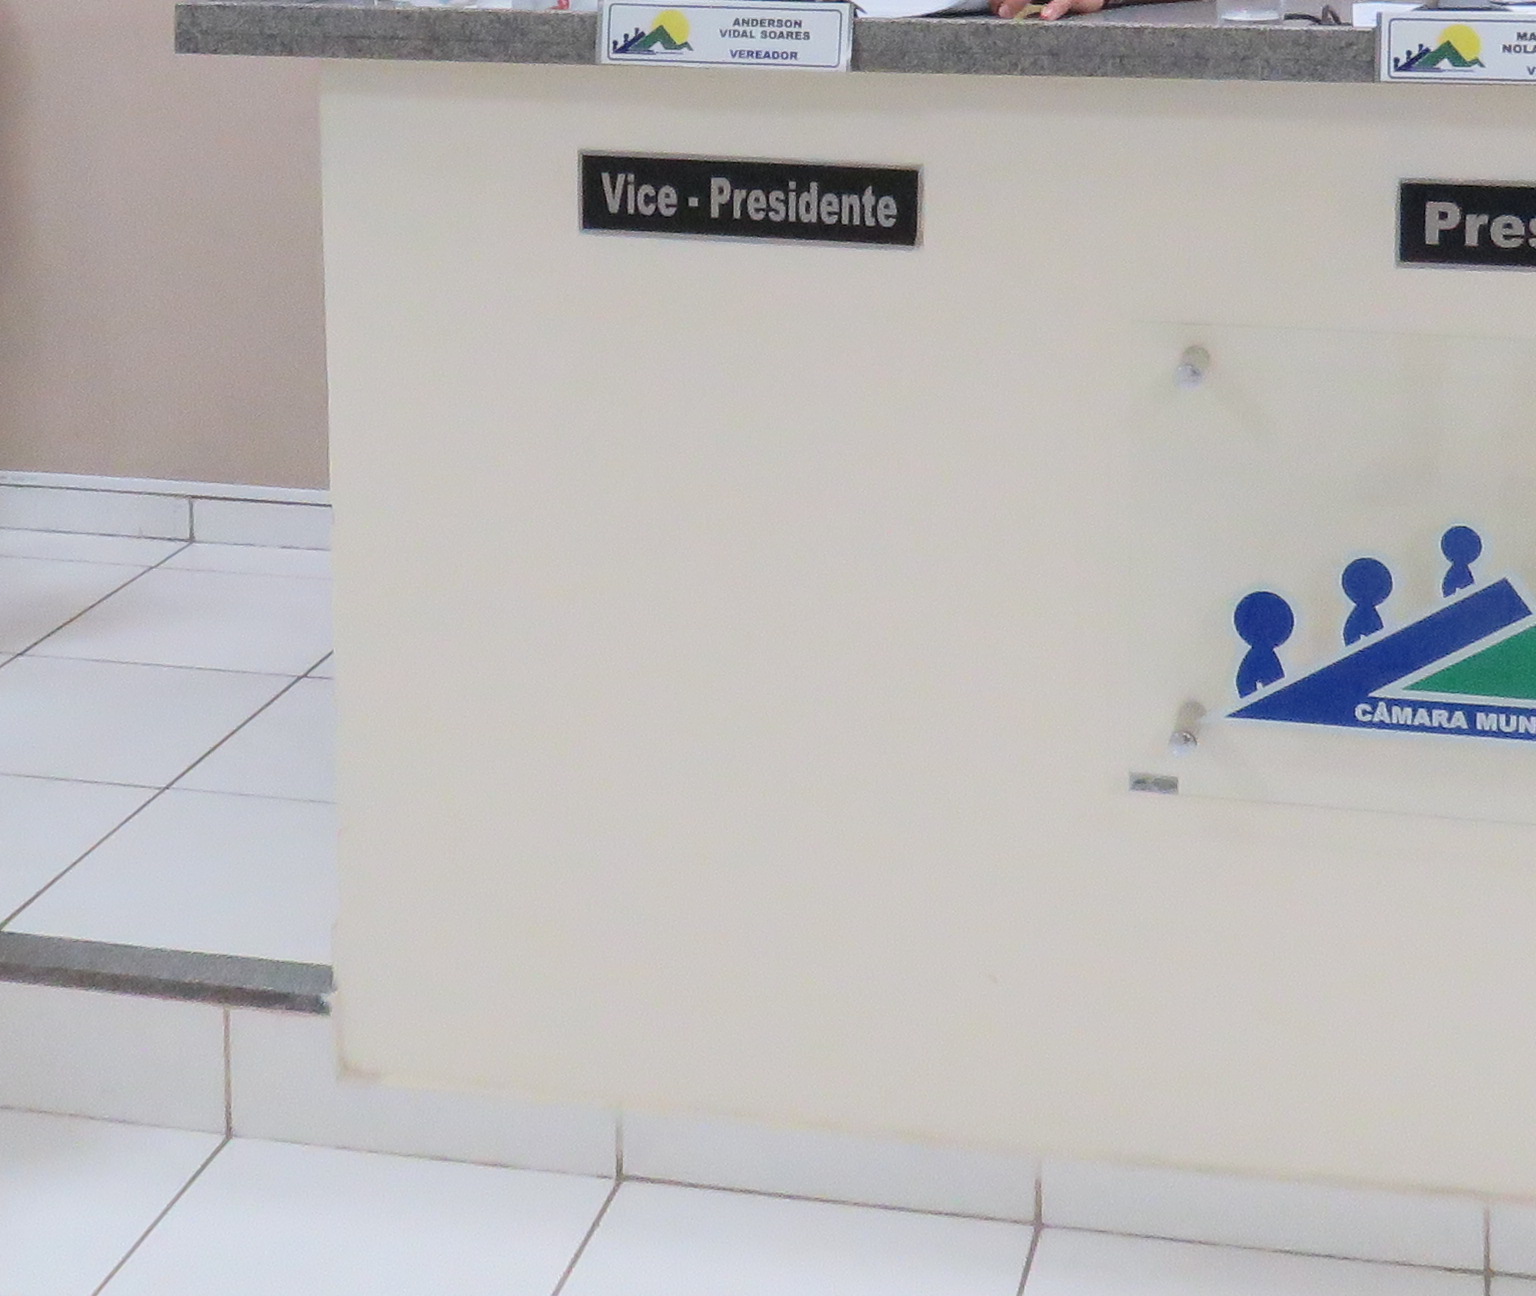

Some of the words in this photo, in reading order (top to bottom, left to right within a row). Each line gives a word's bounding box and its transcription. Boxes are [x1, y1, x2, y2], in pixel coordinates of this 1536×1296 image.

[732, 17, 803, 29] ANDERSON
[719, 29, 756, 39] VIDAL
[760, 30, 811, 41] SOARES
[729, 49, 798, 60] VEREADOR
[600, 171, 678, 217] Vice
[710, 177, 899, 228] Presidente
[1354, 701, 1469, 730] CÂMARA
